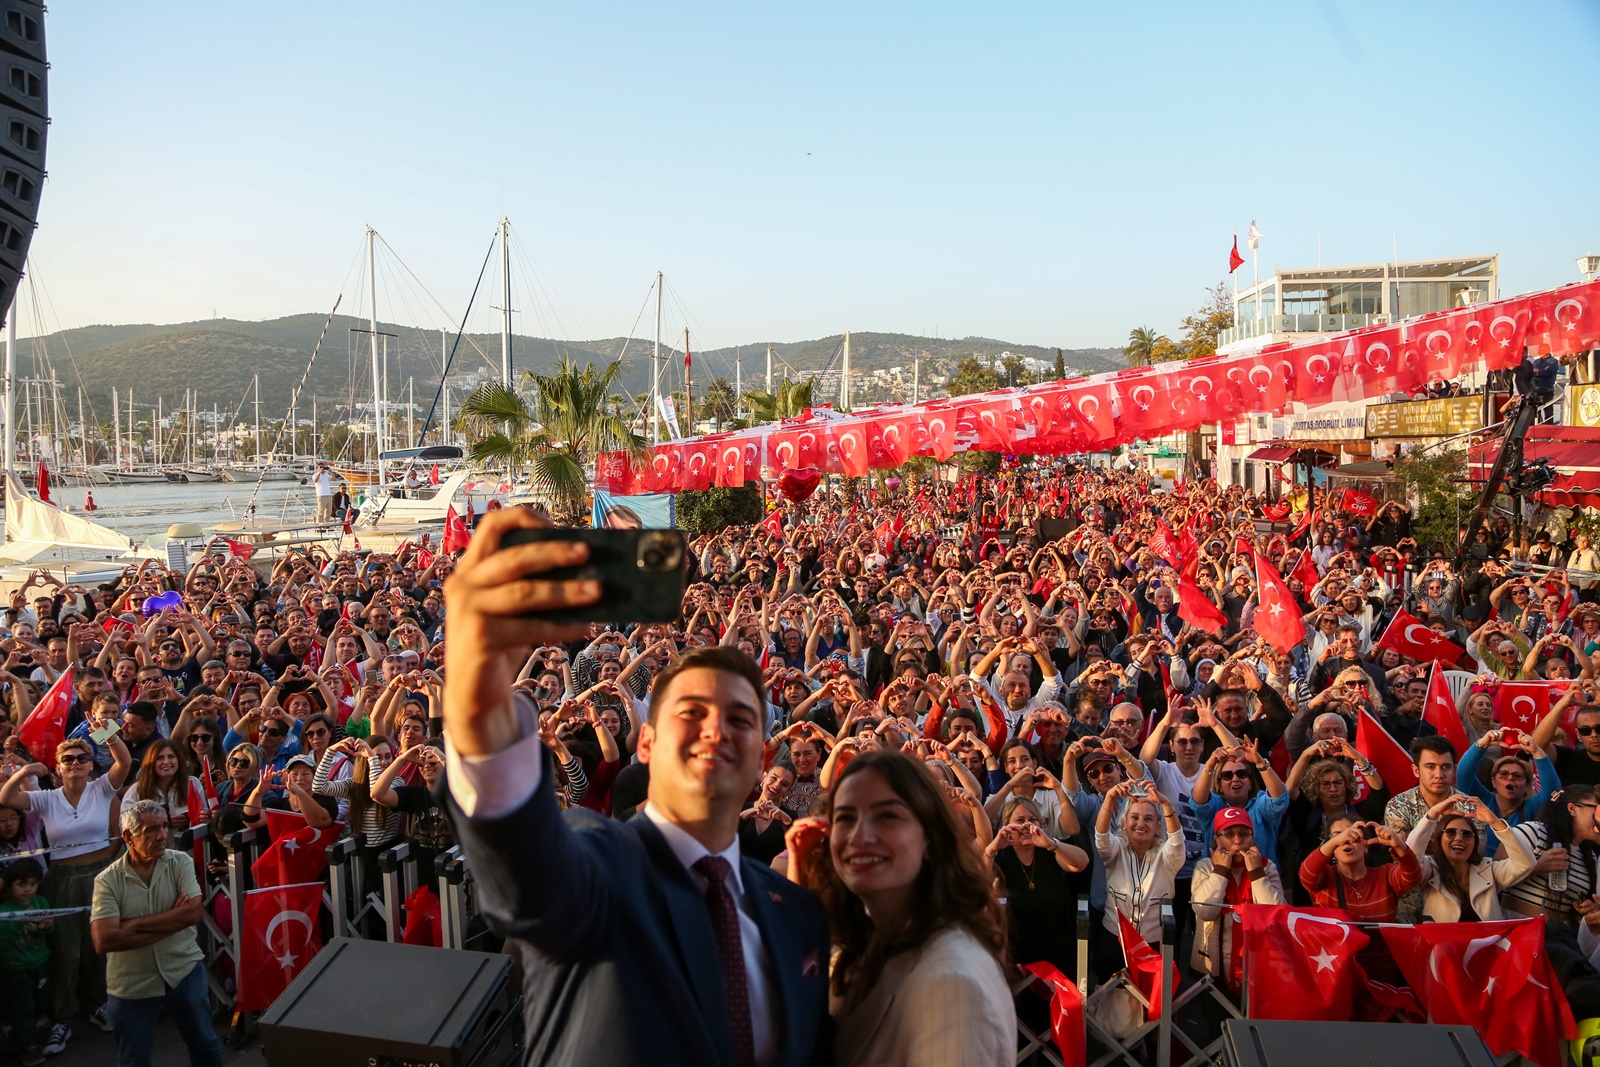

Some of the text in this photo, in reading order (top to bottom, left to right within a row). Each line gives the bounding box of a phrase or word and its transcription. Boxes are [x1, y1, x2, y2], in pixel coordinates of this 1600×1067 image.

[1403, 400, 1446, 415] BODRUM CAFÉ
[1315, 418, 1340, 430] BODRUM
[1405, 414, 1443, 425] RESTAURANT
[604, 468, 622, 478] CHP
[1351, 503, 1367, 511] CHP
